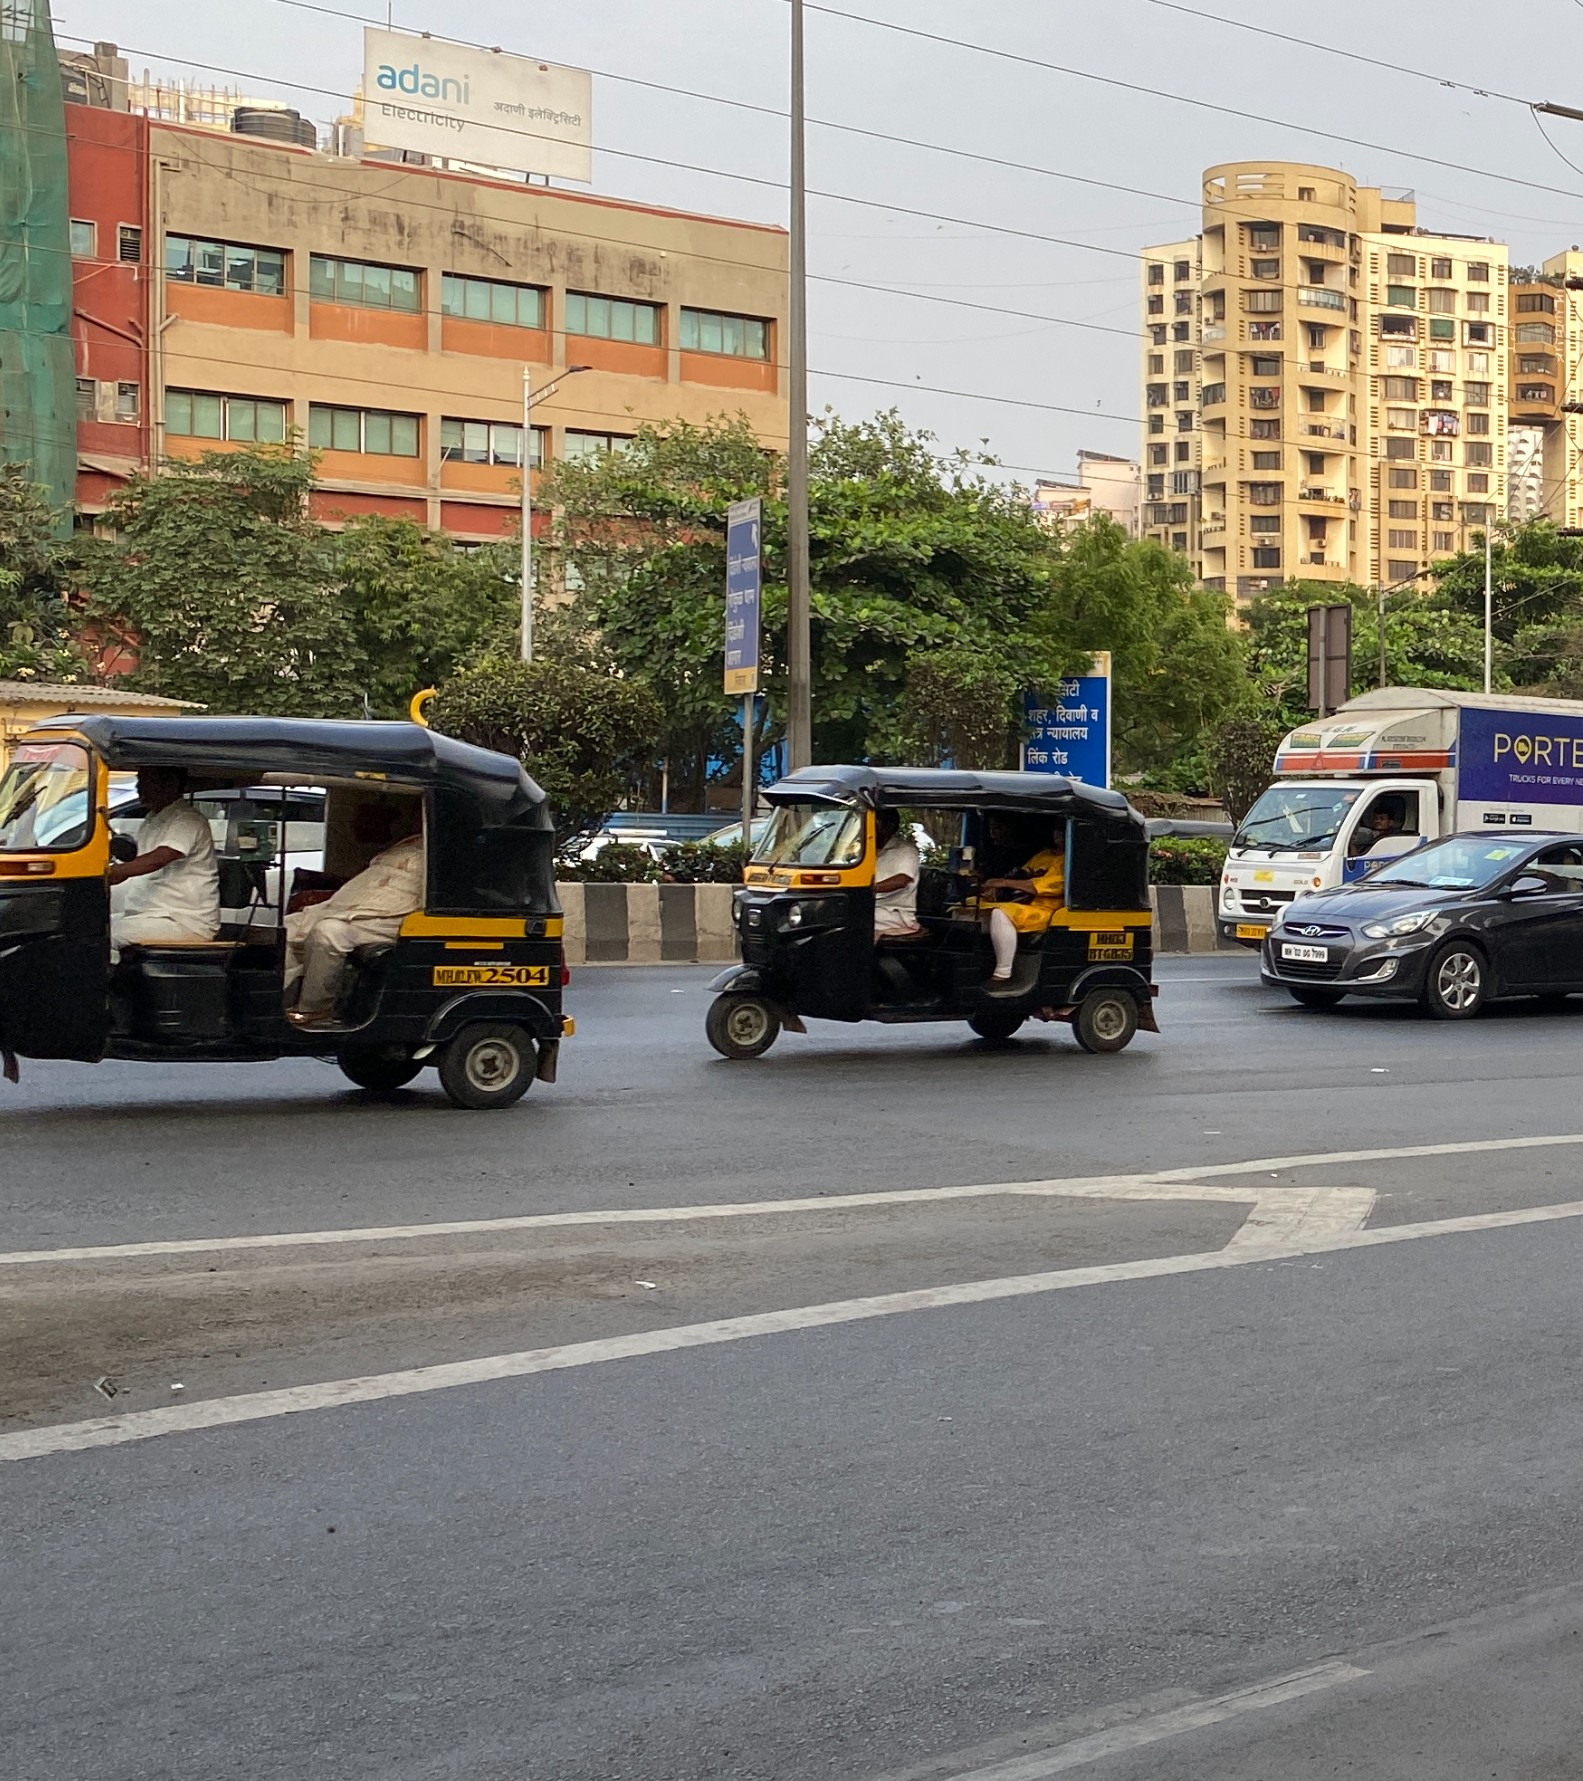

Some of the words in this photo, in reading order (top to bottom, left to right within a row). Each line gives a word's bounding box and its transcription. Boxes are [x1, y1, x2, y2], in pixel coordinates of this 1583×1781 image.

[376, 63, 470, 105] adani
[381, 102, 465, 132] Electricity
[493, 101, 526, 117] अदाणी
[1056, 704, 1088, 723] दिवाणी
[1090, 709, 1099, 721] व
[1047, 727, 1089, 740] न्यायालय
[1027, 747, 1048, 764] लिंक
[1052, 747, 1068, 764] रोड
[1509, 773, 1536, 784] TRUCKS
[1537, 775, 1552, 784] FOR
[1552, 776, 1575, 785] EVERY
